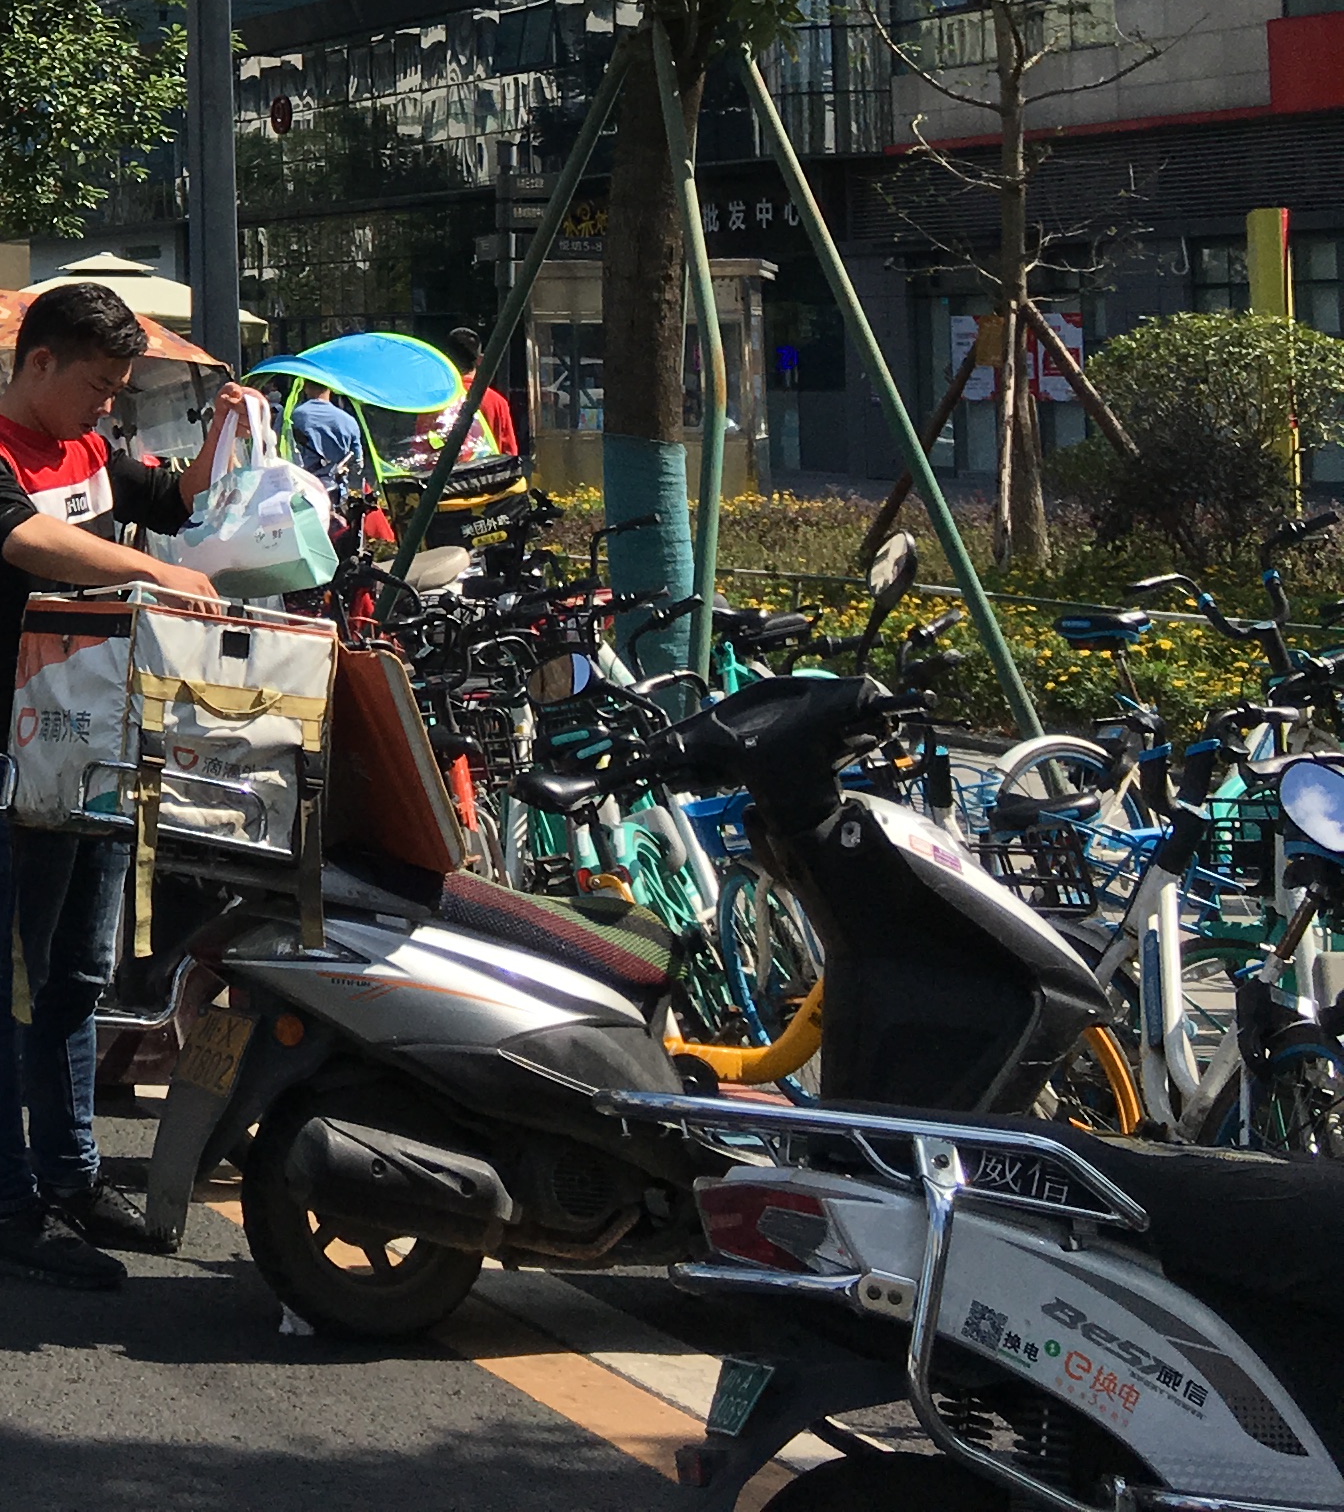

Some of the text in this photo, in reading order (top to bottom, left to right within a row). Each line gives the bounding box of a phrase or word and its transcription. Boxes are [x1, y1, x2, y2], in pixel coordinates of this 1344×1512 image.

[703, 197, 801, 233] 批发中心
[39, 709, 91, 745] 滴滴外卖
[971, 1150, 1069, 1204] 威信
[1001, 1330, 1040, 1363] 换电
[1155, 1364, 1209, 1409] 威信
